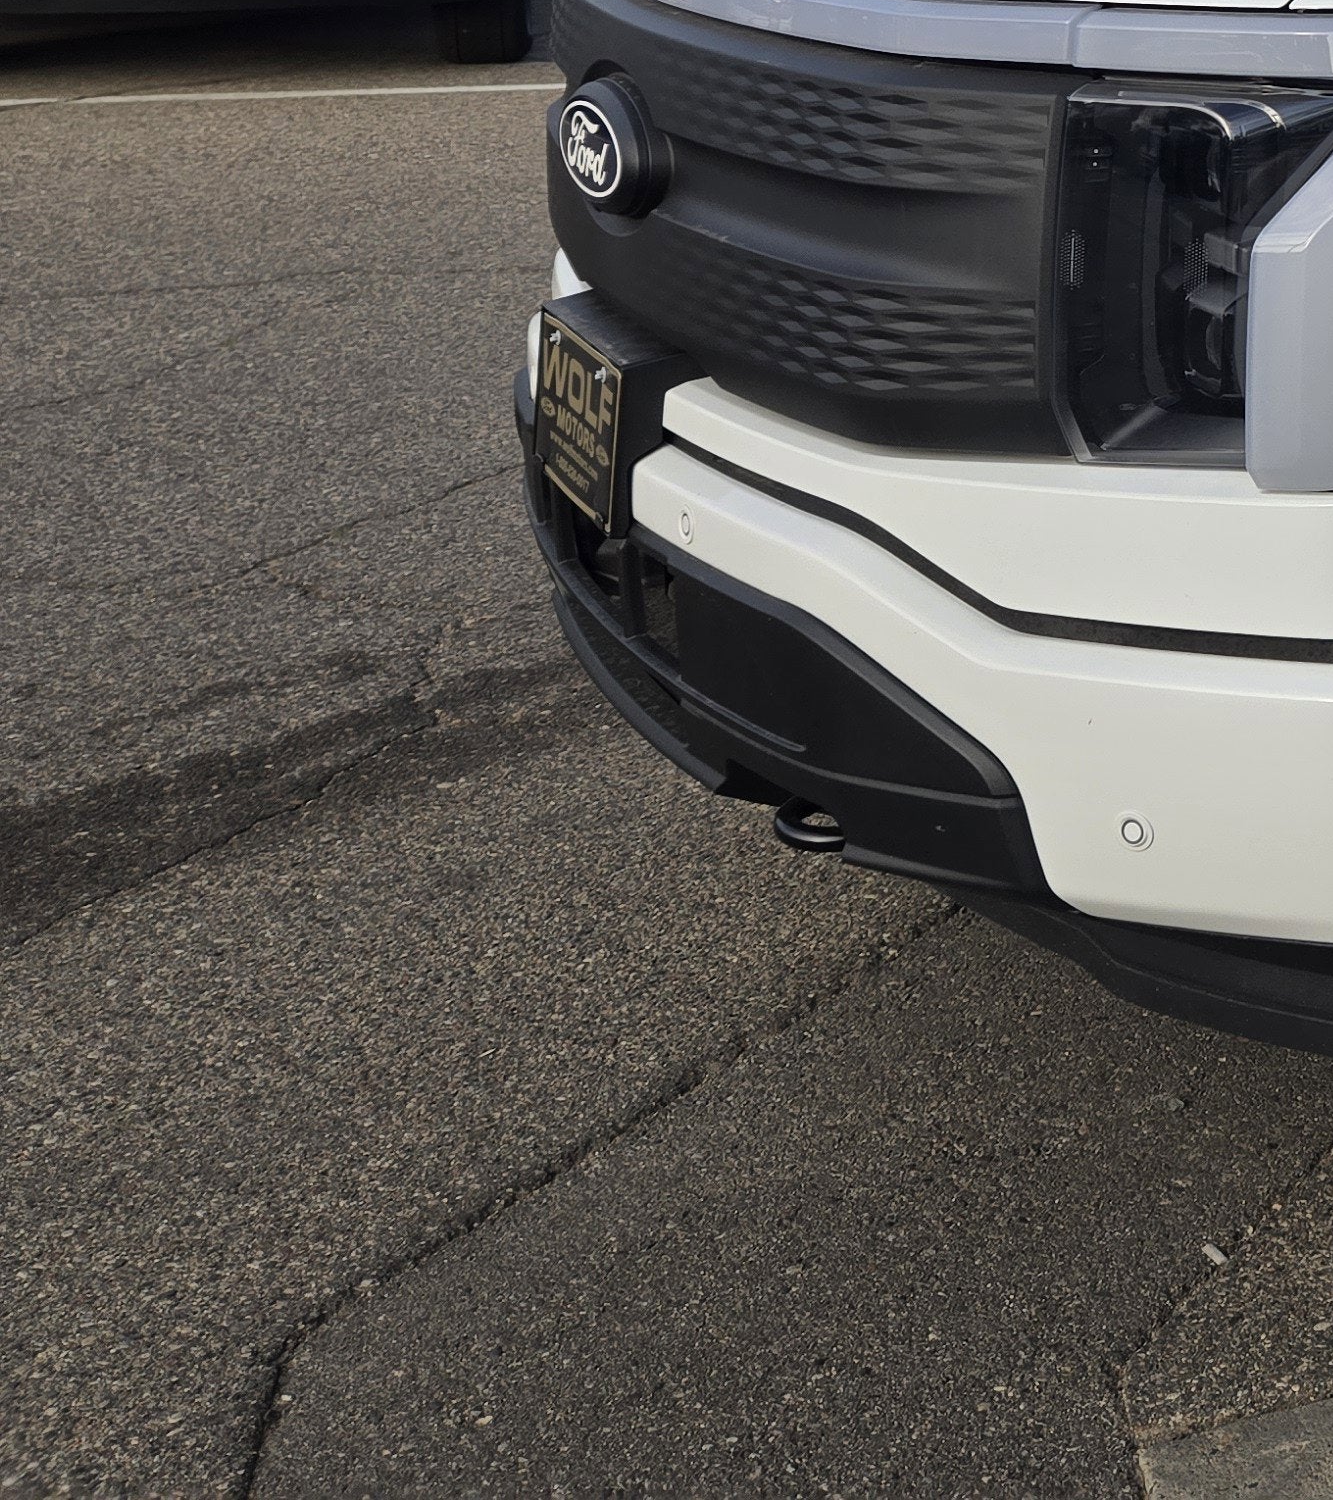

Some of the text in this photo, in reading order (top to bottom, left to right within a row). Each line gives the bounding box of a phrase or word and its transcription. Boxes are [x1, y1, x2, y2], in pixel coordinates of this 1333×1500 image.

[567, 110, 610, 186] Ford
[543, 338, 614, 435] WOLF
[556, 404, 596, 458] MOTORS
